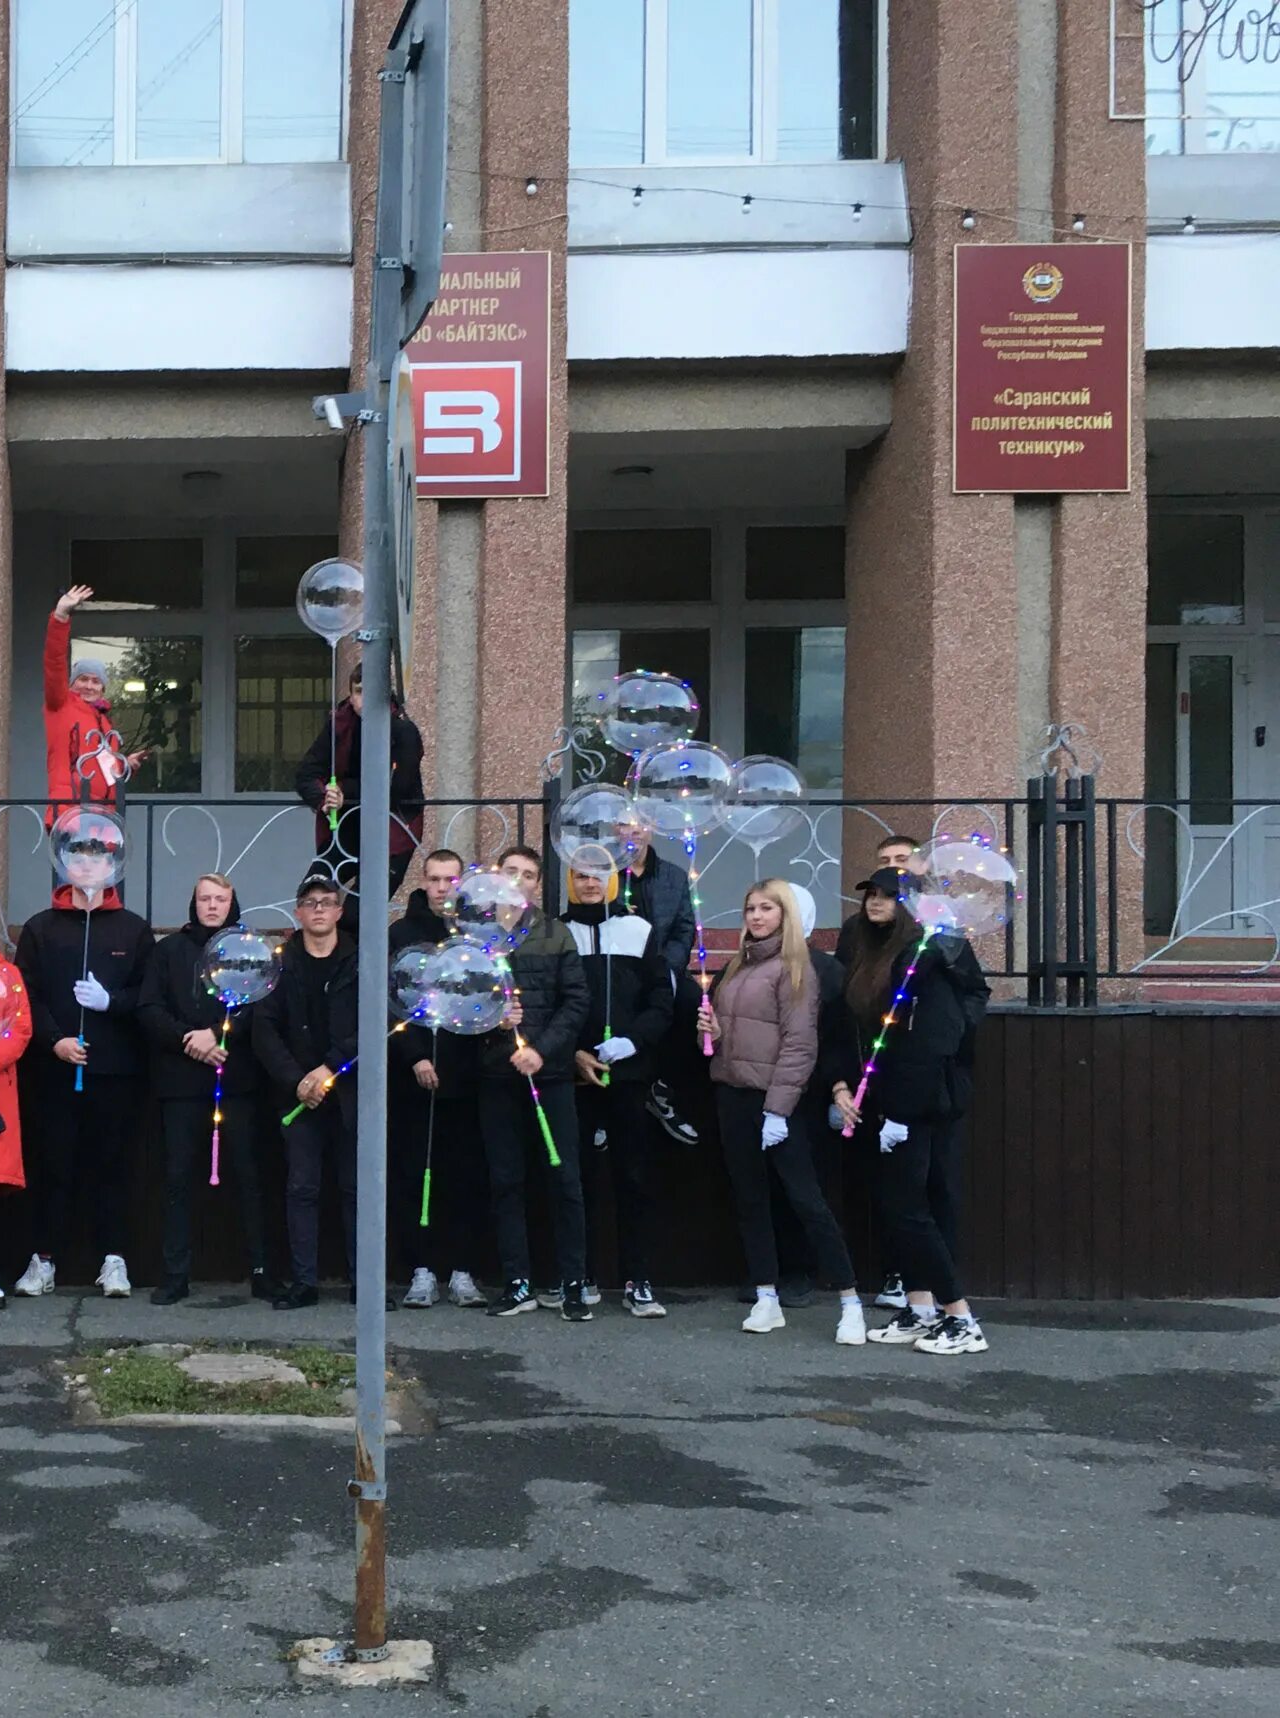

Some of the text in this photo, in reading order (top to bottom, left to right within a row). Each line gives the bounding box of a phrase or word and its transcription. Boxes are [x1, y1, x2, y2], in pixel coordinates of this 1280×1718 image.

[439, 267, 521, 290] ИАЛЬНЫЙ
[411, 321, 527, 343] ОО «БАЙТЭКС»
[993, 387, 1091, 410] «Саранский
[971, 411, 1113, 431] политехнический
[998, 440, 1085, 458] техникум»
